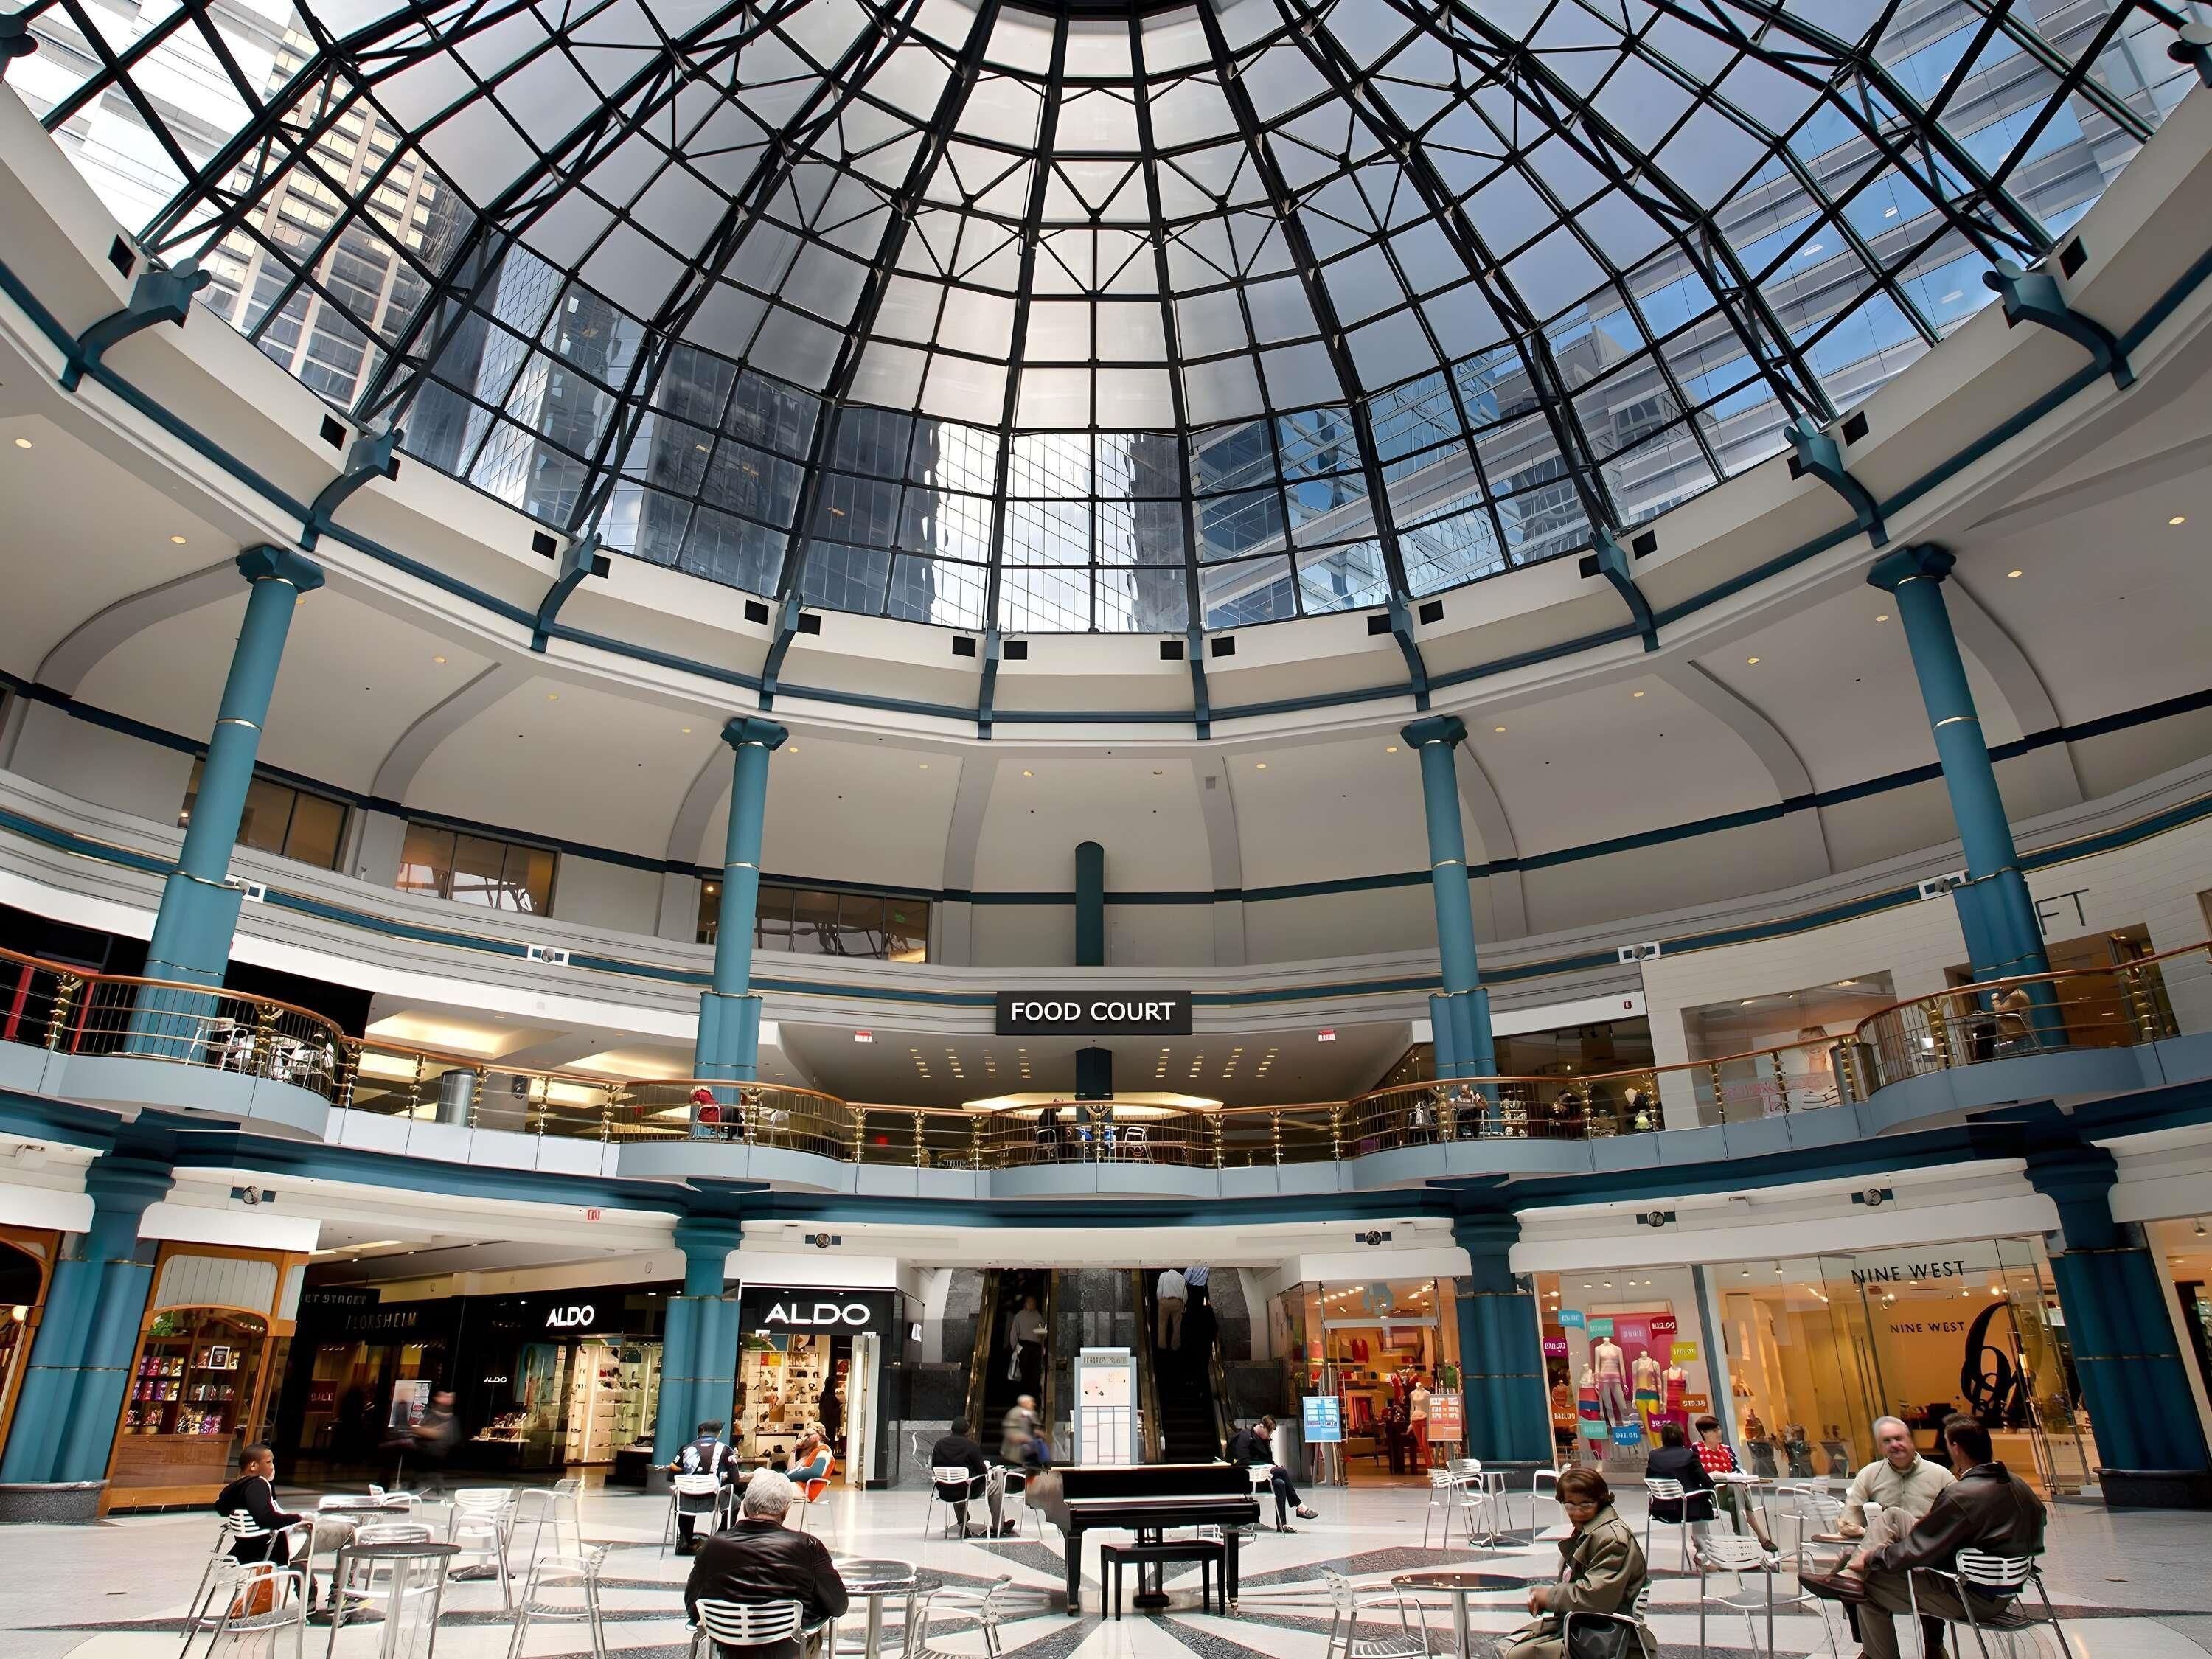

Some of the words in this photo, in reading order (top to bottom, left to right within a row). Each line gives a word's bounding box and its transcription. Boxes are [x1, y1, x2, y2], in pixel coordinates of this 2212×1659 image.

[1011, 1001, 1081, 1020] FOOD
[1090, 1001, 1176, 1020] COURT
[1851, 1267, 1901, 1284] NINE
[1908, 1261, 1965, 1279] WEST
[546, 1305, 594, 1327] ALDO
[764, 1303, 871, 1324] ALDO
[1891, 1324, 1923, 1333] NINE
[1927, 1321, 1964, 1332] WEST
